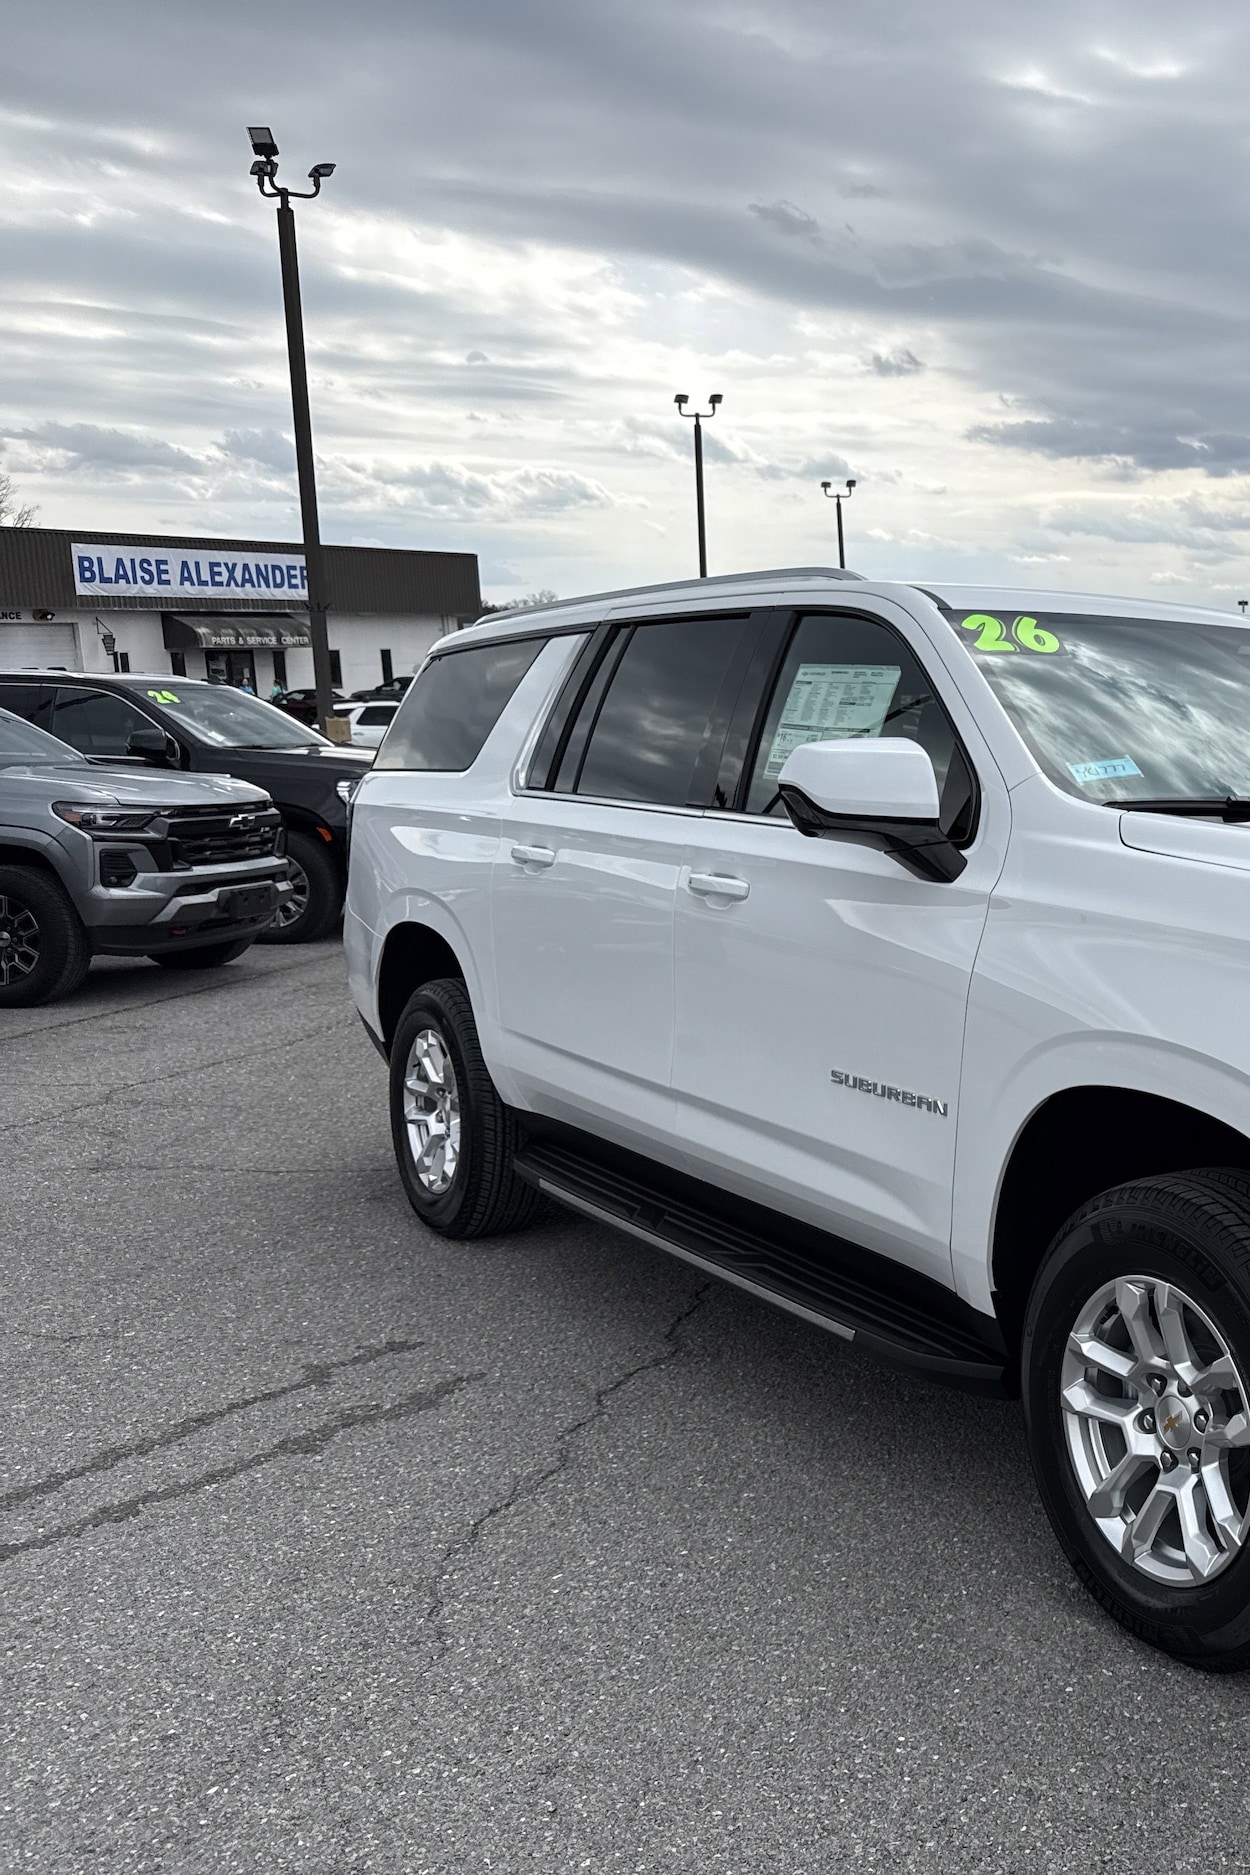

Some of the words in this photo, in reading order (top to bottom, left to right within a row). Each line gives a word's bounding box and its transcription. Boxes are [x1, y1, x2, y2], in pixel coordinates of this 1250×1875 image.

[77, 555, 171, 586] BLAISE
[0, 611, 22, 620] NCE
[211, 636, 236, 645] PARTS
[238, 636, 244, 645] &
[246, 636, 278, 645] SERVICE
[281, 636, 310, 645] CENTER
[961, 614, 1060, 654] 26
[830, 1069, 948, 1117] SUBURBAN
